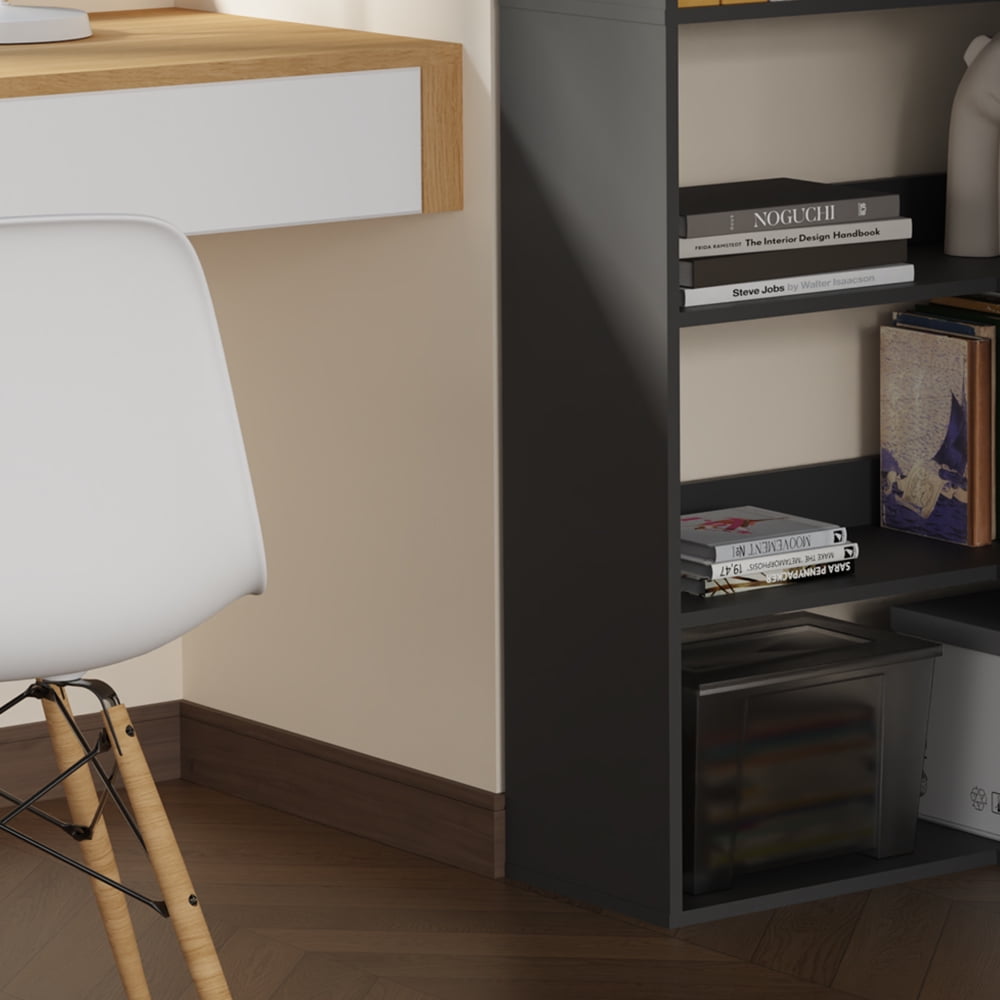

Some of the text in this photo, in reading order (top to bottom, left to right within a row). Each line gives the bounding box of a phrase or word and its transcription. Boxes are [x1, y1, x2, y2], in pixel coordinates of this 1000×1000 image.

[753, 204, 836, 229] NOGUCHI
[712, 241, 742, 249] RAMSTEDT
[745, 238, 763, 248] The
[763, 234, 798, 246] Interior
[798, 233, 831, 243] Design
[832, 227, 881, 240] Handbook
[732, 274, 876, 298] Steve Jobs by Walter Isaacson
[747, 535, 812, 556] MOOVEMENT
[804, 554, 817, 564] THE
[817, 552, 834, 561] MAKE
[719, 562, 743, 577] 19,47
[766, 561, 851, 584] SARA PENNYPACKER
